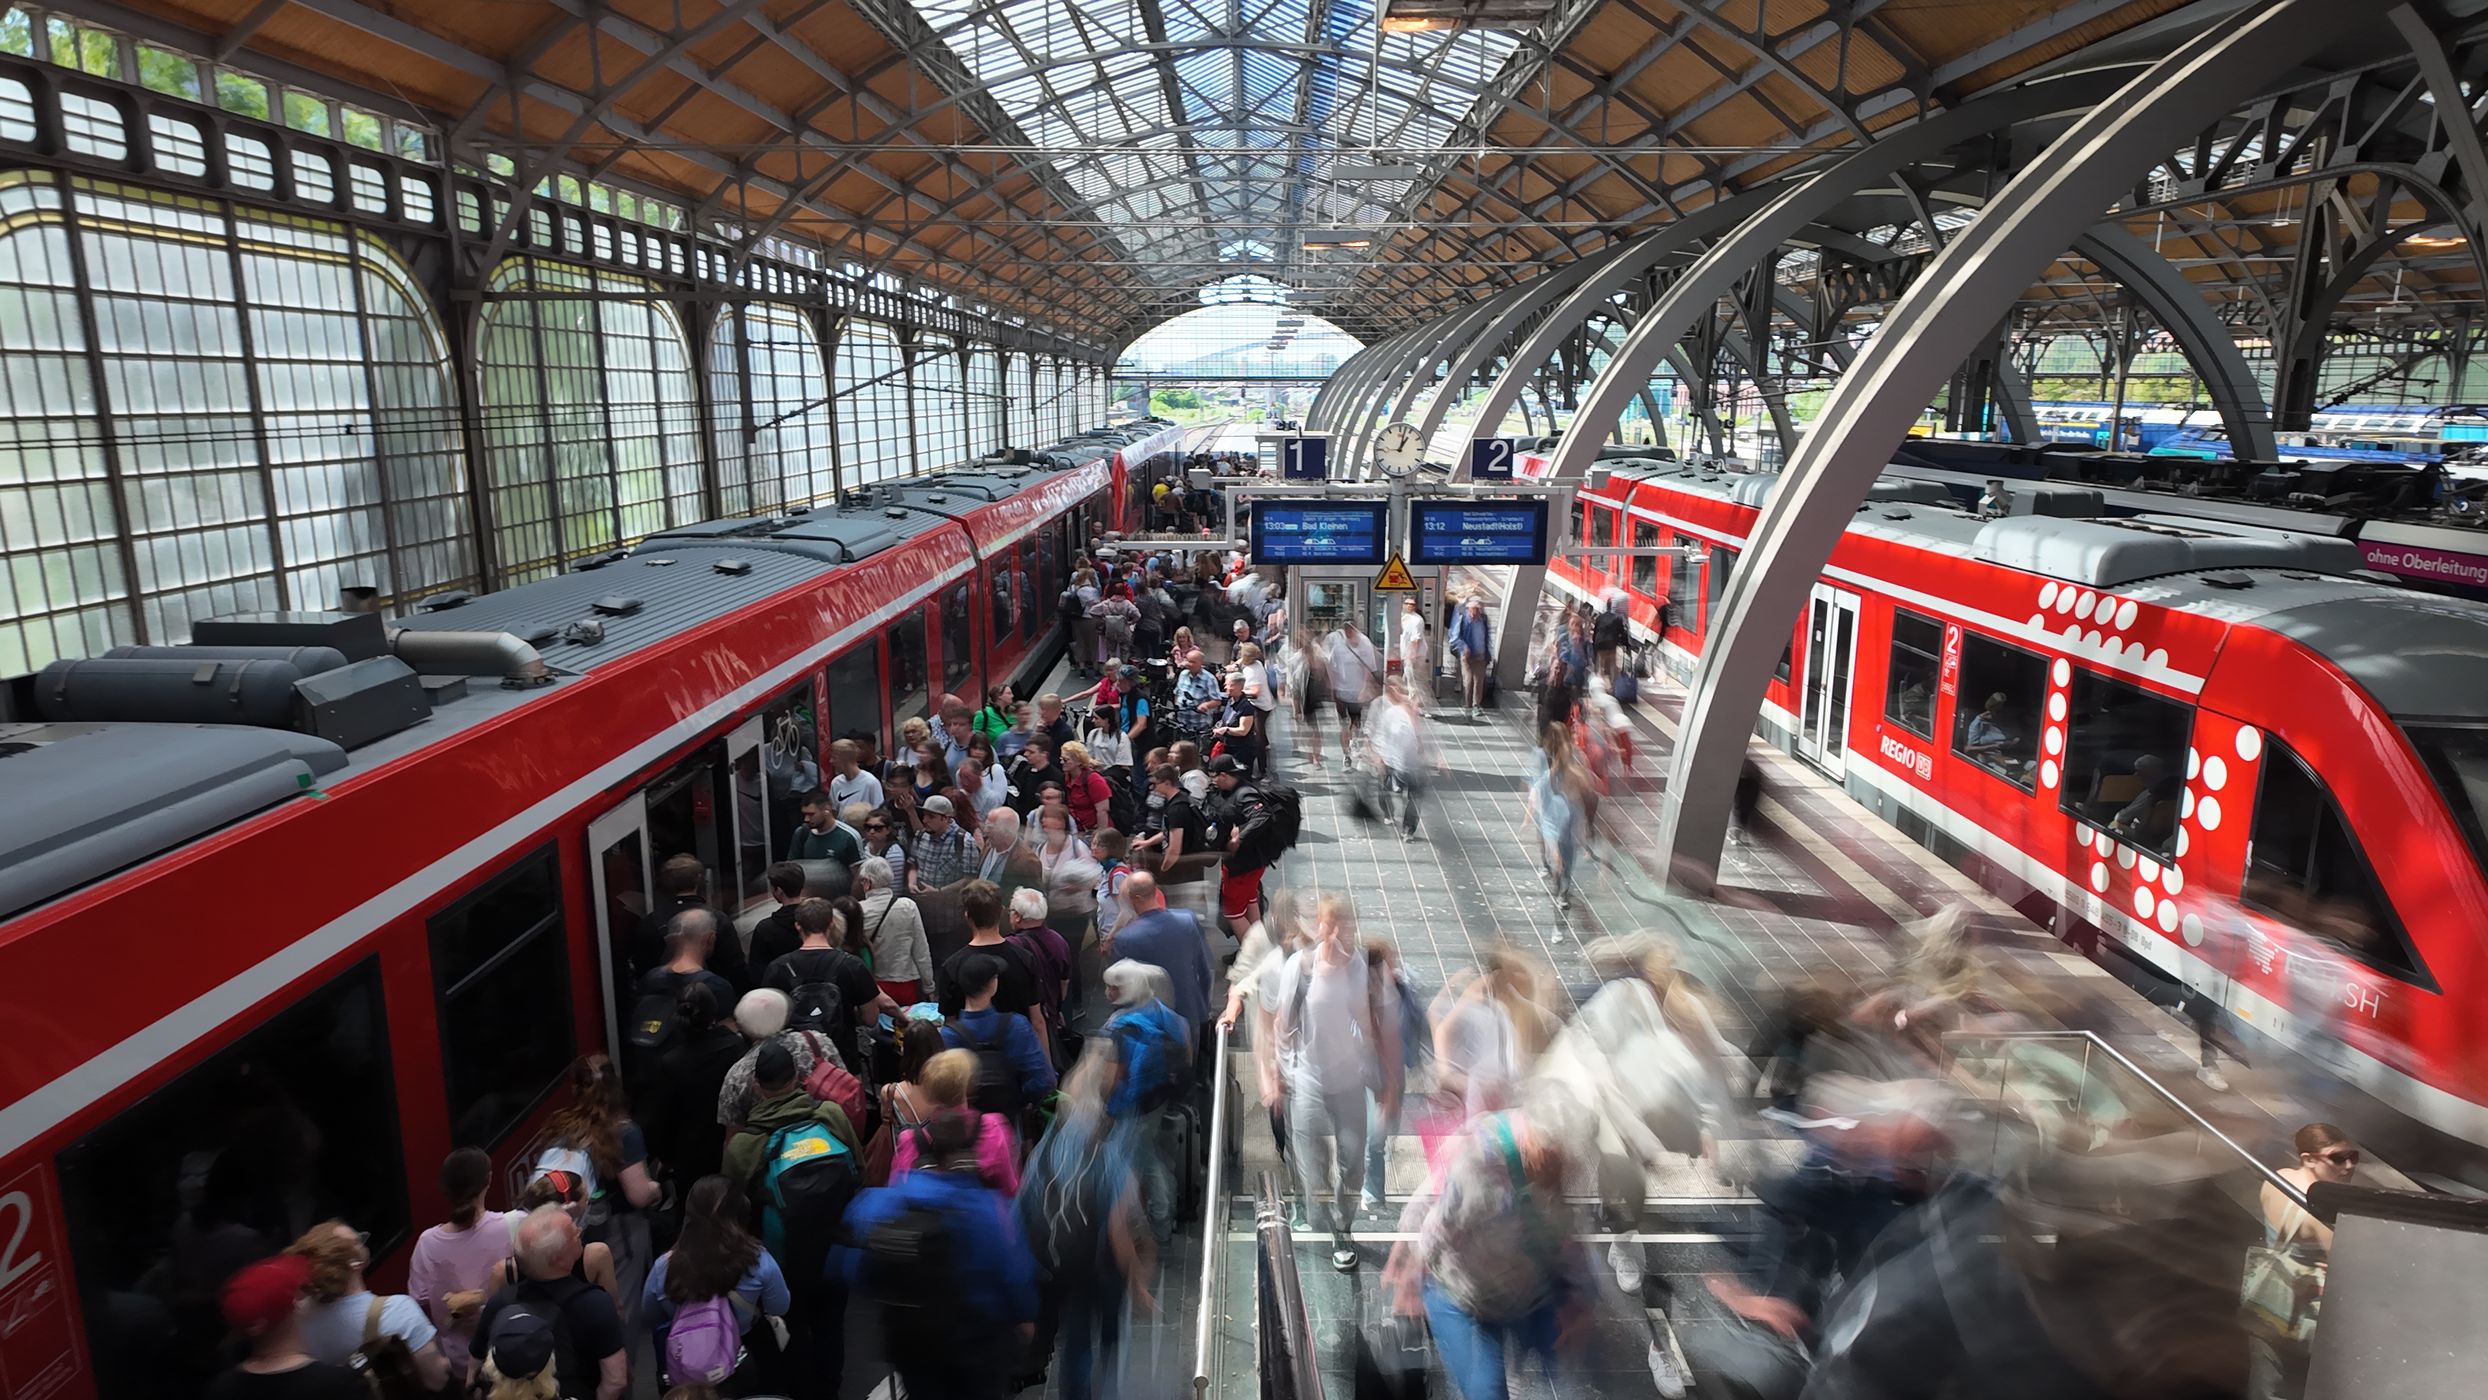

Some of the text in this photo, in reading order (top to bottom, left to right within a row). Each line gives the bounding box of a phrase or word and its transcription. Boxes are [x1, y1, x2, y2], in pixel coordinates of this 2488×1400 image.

[1289, 440, 1303, 471] 1
[1487, 440, 1508, 472] 2
[1302, 522, 1317, 530] Bad
[1320, 522, 1348, 530] Kleinen
[1424, 522, 1446, 531] 13:12
[2367, 548, 2488, 583] ohne Oberleitung
[1947, 625, 1959, 655] 2
[817, 671, 826, 704] 2
[1880, 734, 1916, 769] REGIO
[0, 1190, 43, 1290] 2
